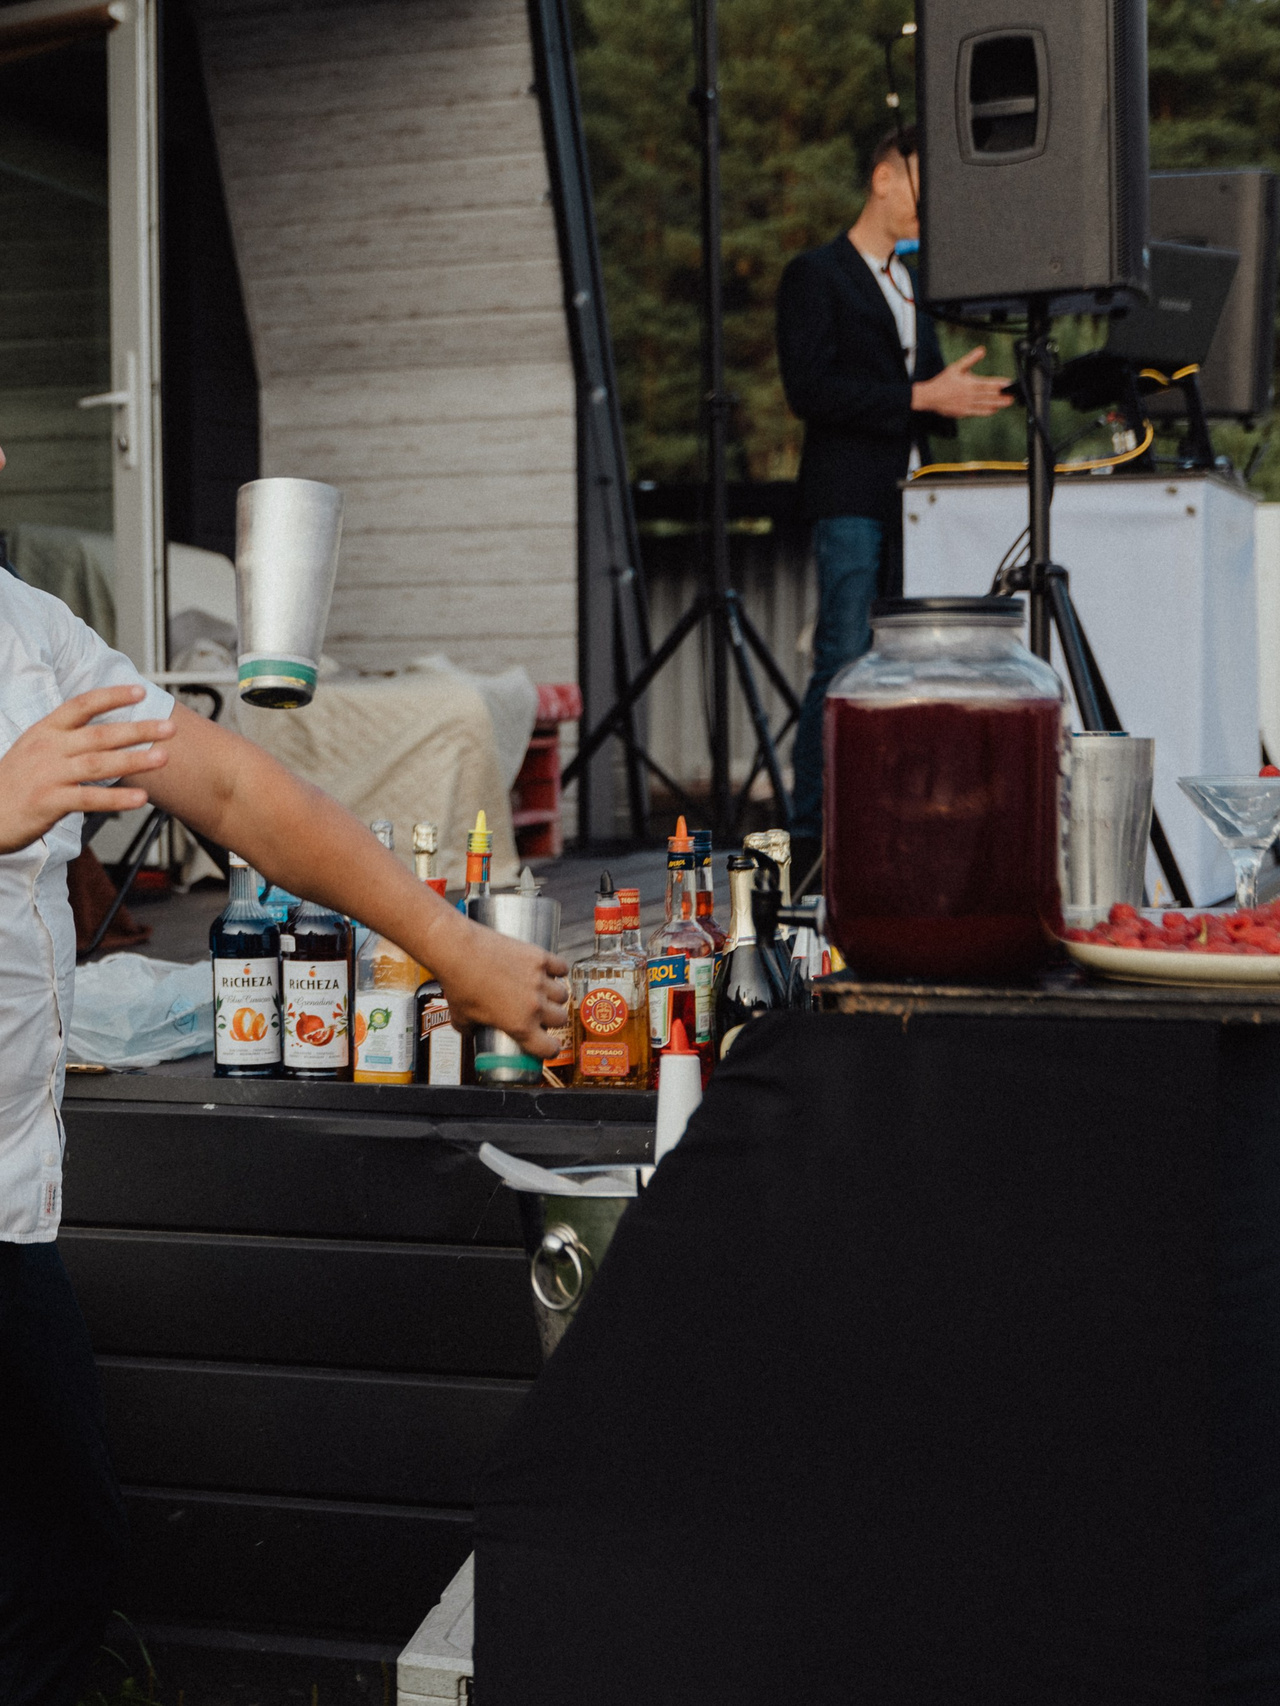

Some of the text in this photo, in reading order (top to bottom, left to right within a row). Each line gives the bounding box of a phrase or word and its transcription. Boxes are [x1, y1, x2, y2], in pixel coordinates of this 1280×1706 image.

[647, 964, 677, 982] EROL
[586, 991, 622, 1007] OLMECA
[424, 1009, 451, 1031] COINT
[586, 1016, 624, 1033] TEQUILA
